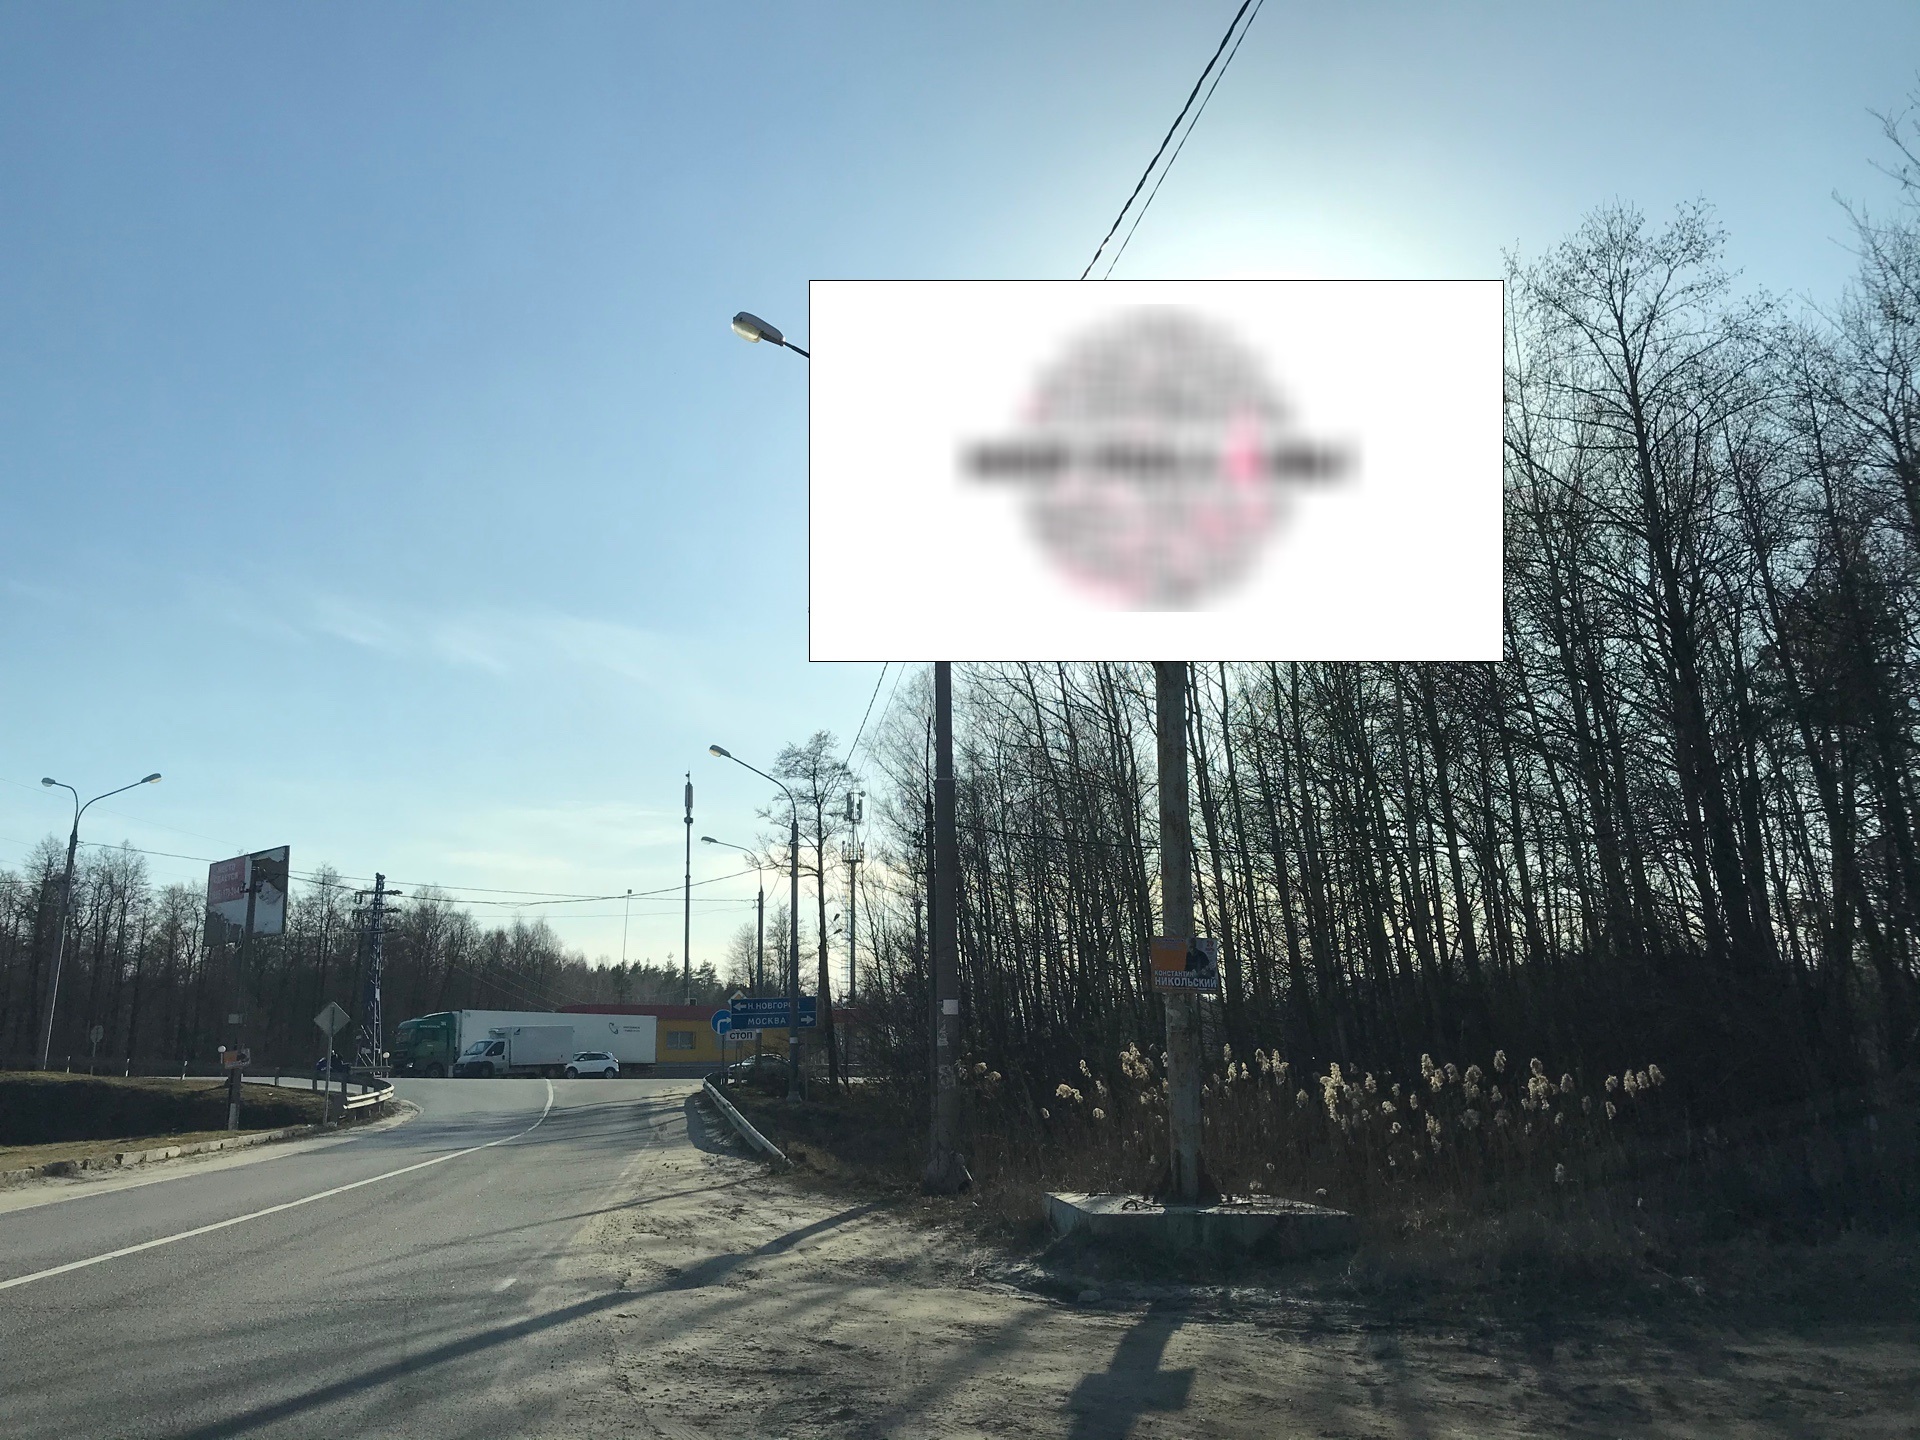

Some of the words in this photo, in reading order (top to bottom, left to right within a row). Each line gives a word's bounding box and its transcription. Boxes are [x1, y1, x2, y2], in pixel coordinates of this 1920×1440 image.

[1154, 970, 1194, 978] КОНСТАНТИН
[1154, 976, 1217, 988] НИКОЛЬСКИЙ
[747, 1017, 786, 1025] МОСКВА
[729, 1032, 753, 1040] СТОП
